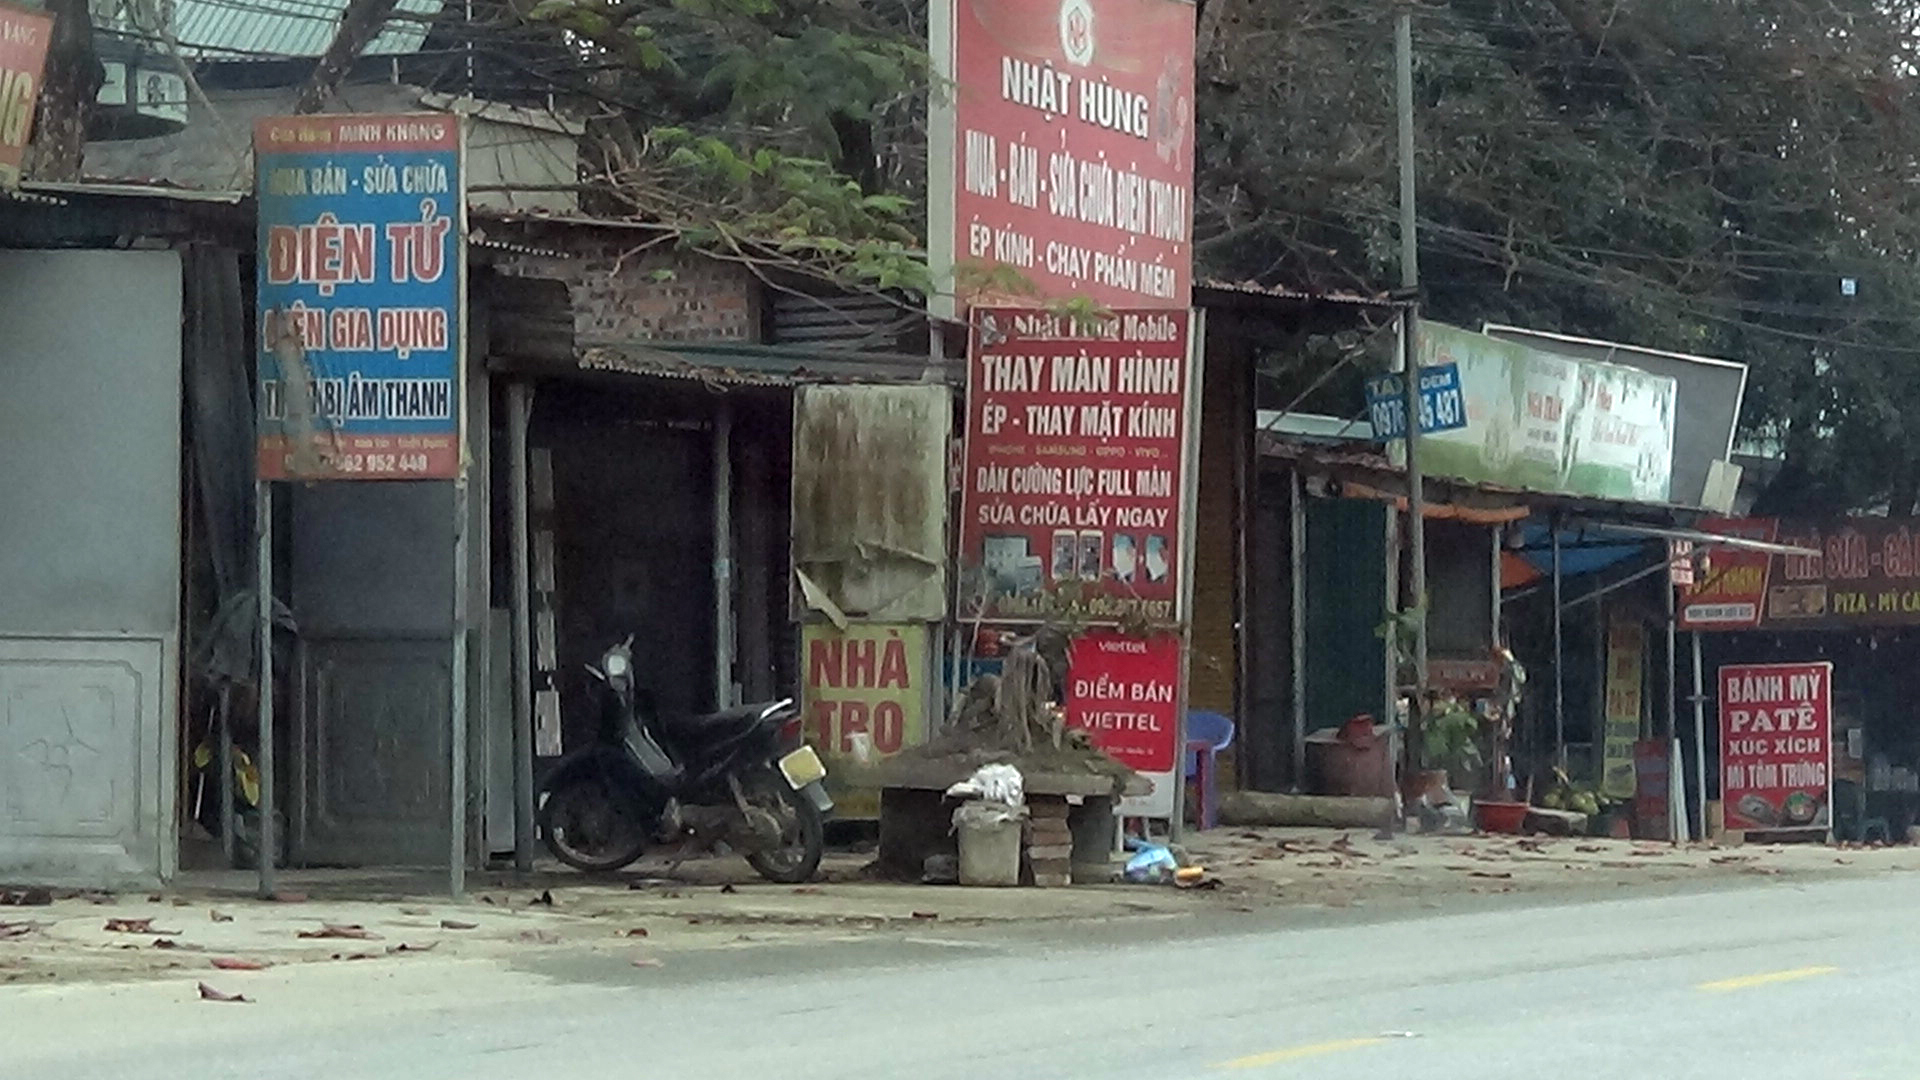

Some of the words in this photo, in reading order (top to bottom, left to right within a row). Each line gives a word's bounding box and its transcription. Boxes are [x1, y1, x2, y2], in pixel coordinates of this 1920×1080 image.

[1002, 56, 1072, 122] NHẬT
[1080, 76, 1149, 139] HÙNG
[339, 125, 381, 142] MINH
[386, 124, 445, 141] KHANG
[311, 160, 347, 195] BÁN
[363, 154, 398, 194] SỬA
[402, 158, 448, 194] CHỮA
[965, 129, 998, 199] MUA
[1008, 131, 1039, 209] BÁN
[1049, 128, 1077, 218] SỬA
[1079, 151, 1115, 226] CHỮA
[1116, 162, 1148, 246] ĐIỆN
[1149, 179, 1186, 255] THOẠI
[268, 212, 375, 297] ĐIỆN
[386, 198, 451, 283] TỬ
[969, 214, 991, 258] ÉP
[994, 223, 1034, 268] KÍNH
[1046, 241, 1091, 289] CHẠY
[331, 308, 374, 351] GIA
[377, 307, 447, 359] DỤNG
[1123, 314, 1177, 342] Mobile
[981, 355, 1045, 392] THAY
[1051, 349, 1111, 393] MÀN
[1118, 350, 1180, 394] HÌNH
[323, 377, 345, 427] BỊ
[346, 370, 381, 419] ÂM
[383, 378, 451, 419] THANH
[982, 398, 1007, 434] ÉP
[1026, 405, 1075, 436] THAY
[1080, 400, 1124, 443] MẶT
[1128, 401, 1176, 438] KÍNH
[976, 462, 1008, 493] DÁN
[1011, 462, 1063, 496] CƯỜNG
[1065, 465, 1094, 500] LỰC
[1097, 469, 1133, 496] FULL
[1136, 464, 1172, 498] MÀN
[978, 498, 1016, 525] SỬA
[1020, 502, 1070, 526] CHỮA
[1075, 498, 1109, 526] LẤY
[1116, 506, 1169, 528] NGAY
[1833, 592, 1868, 614] PIZA
[809, 628, 910, 689] NHÀ
[1098, 641, 1147, 654] viettel
[1074, 672, 1125, 700] ĐIỂM
[1131, 680, 1173, 703] BÁN
[1727, 671, 1783, 703] BÁNH
[1081, 710, 1161, 732] VIETTEL
[1729, 703, 1818, 733] PATÊ
[1728, 735, 1769, 756] XÚC
[1774, 735, 1820, 755] XÍCH
[1727, 760, 1744, 790] MÌ
[1749, 758, 1777, 789] TÔM
[1781, 757, 1826, 788] TRỨNG
